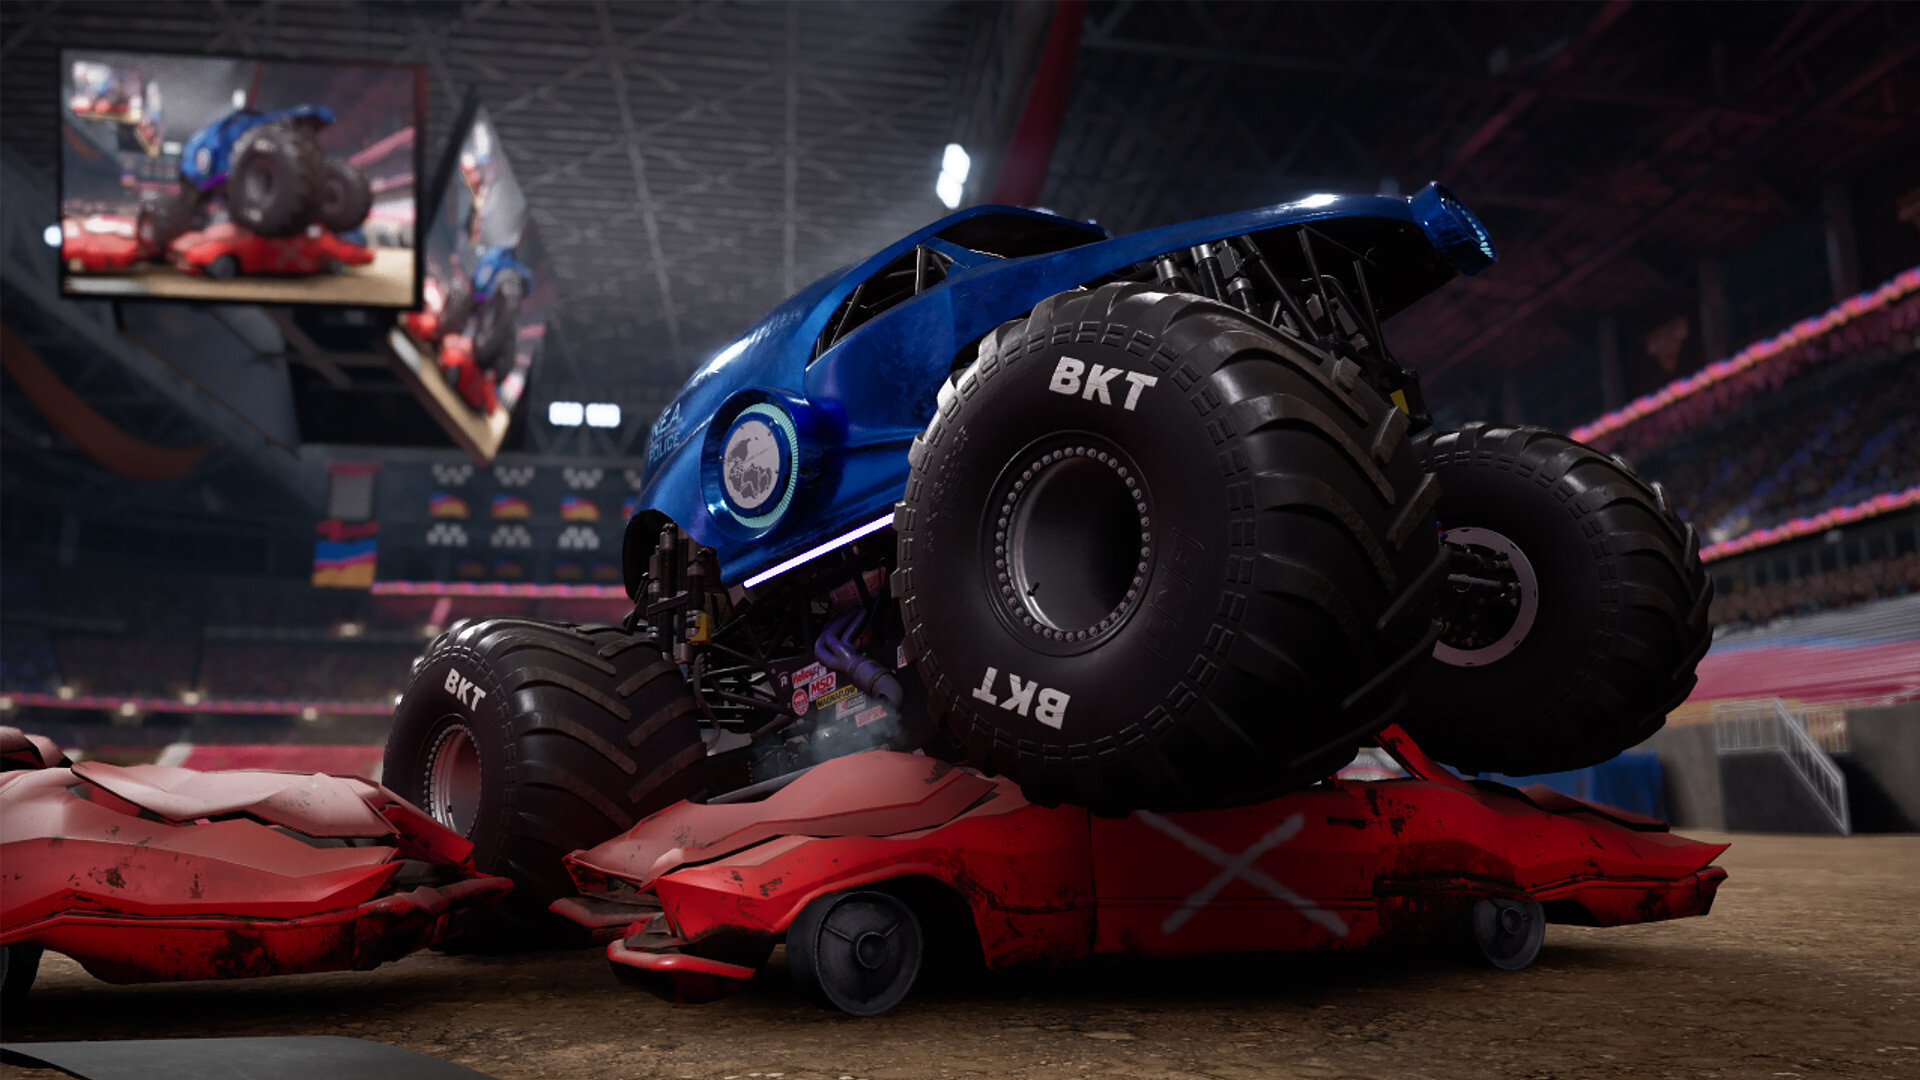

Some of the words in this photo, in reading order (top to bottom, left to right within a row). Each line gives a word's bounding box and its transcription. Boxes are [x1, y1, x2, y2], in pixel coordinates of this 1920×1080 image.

[1049, 356, 1158, 411] BKT
[648, 431, 681, 465] POLICE
[444, 668, 486, 711] BKT
[811, 674, 834, 695] MSD
[972, 666, 1071, 730] BKT
